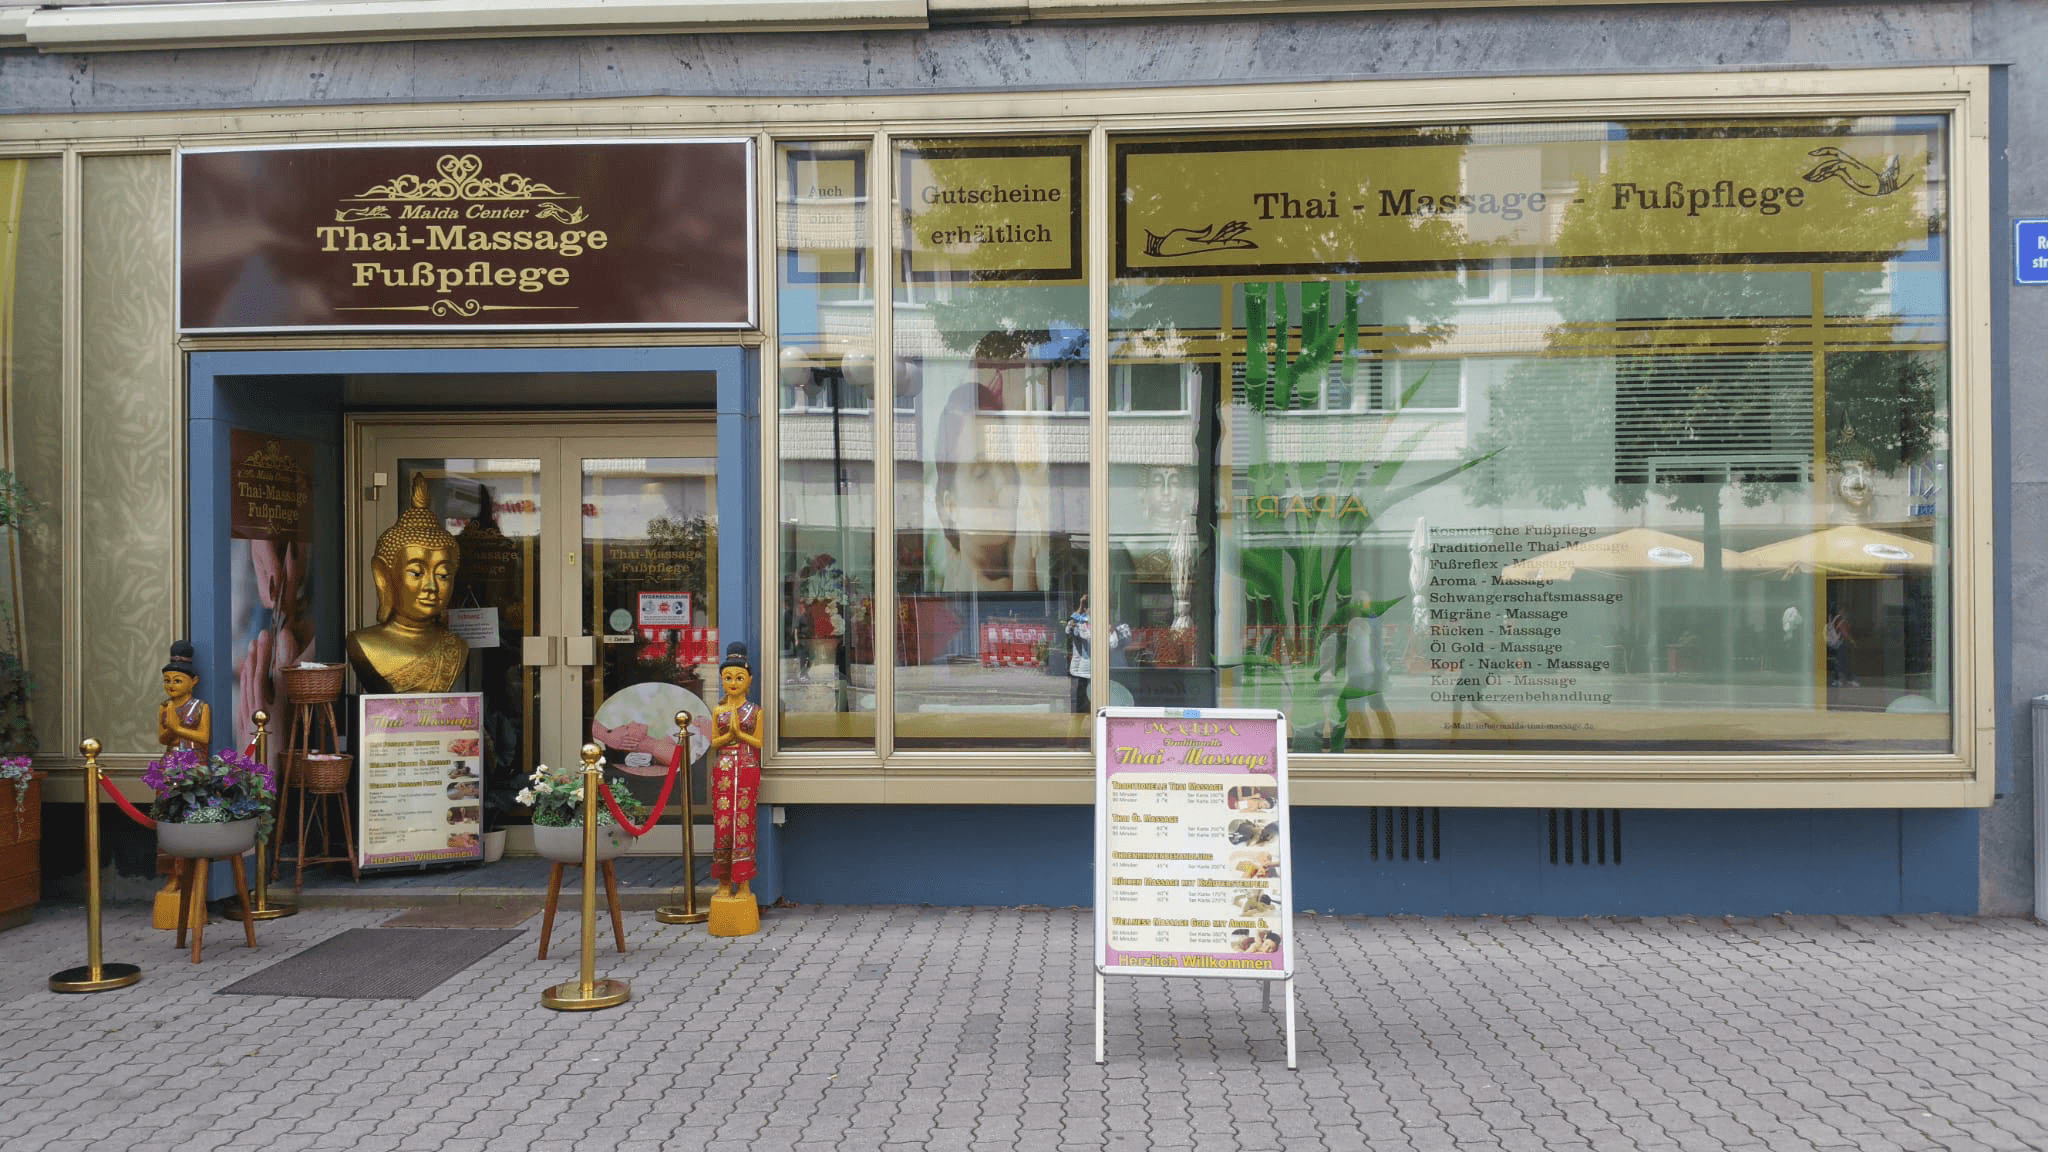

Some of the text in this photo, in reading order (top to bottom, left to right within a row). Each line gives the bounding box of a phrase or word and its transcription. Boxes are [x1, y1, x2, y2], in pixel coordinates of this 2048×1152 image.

[809, 185, 842, 197] Auch
[921, 184, 1062, 205] Gutscheine
[1254, 191, 1338, 220] Thai
[1378, 188, 1548, 220] Massage
[1611, 180, 1806, 217] Fußpflege
[398, 204, 529, 220] Malda Center
[316, 225, 609, 257] Thai-Massage
[930, 224, 1053, 244] erhältlich
[351, 262, 570, 293] Fußpflege
[1430, 525, 1596, 538] Kosmetische Fußpflege
[1430, 542, 1522, 553] Traditionelle
[1430, 559, 1498, 570] Fußreflex
[1513, 559, 1576, 571] Massage
[1429, 575, 1477, 587] Aroma
[1491, 575, 1554, 588] Massage
[1429, 592, 1624, 604] Schwangerschaftsmassage
[1430, 608, 1491, 621] Migräne
[1506, 608, 1568, 621] Massage
[1430, 625, 1484, 637] Rücken
[1500, 625, 1561, 638] Massage
[1430, 641, 1446, 653] Öl
[1451, 642, 1484, 654] Gold
[1500, 642, 1562, 655] Massage
[1430, 658, 1466, 671] Kopf
[1479, 659, 1532, 670] Nacken
[1547, 659, 1610, 672] Massage
[1431, 675, 1480, 686] Kerzen
[1485, 674, 1502, 686] Öl
[1514, 676, 1577, 688] Massage
[1430, 691, 1613, 705] Ohrenkerzenbehandlung
[1116, 745, 1165, 765] Thai
[1178, 746, 1267, 769] Massage
[1118, 953, 1273, 970] Herzlich Willkommen
